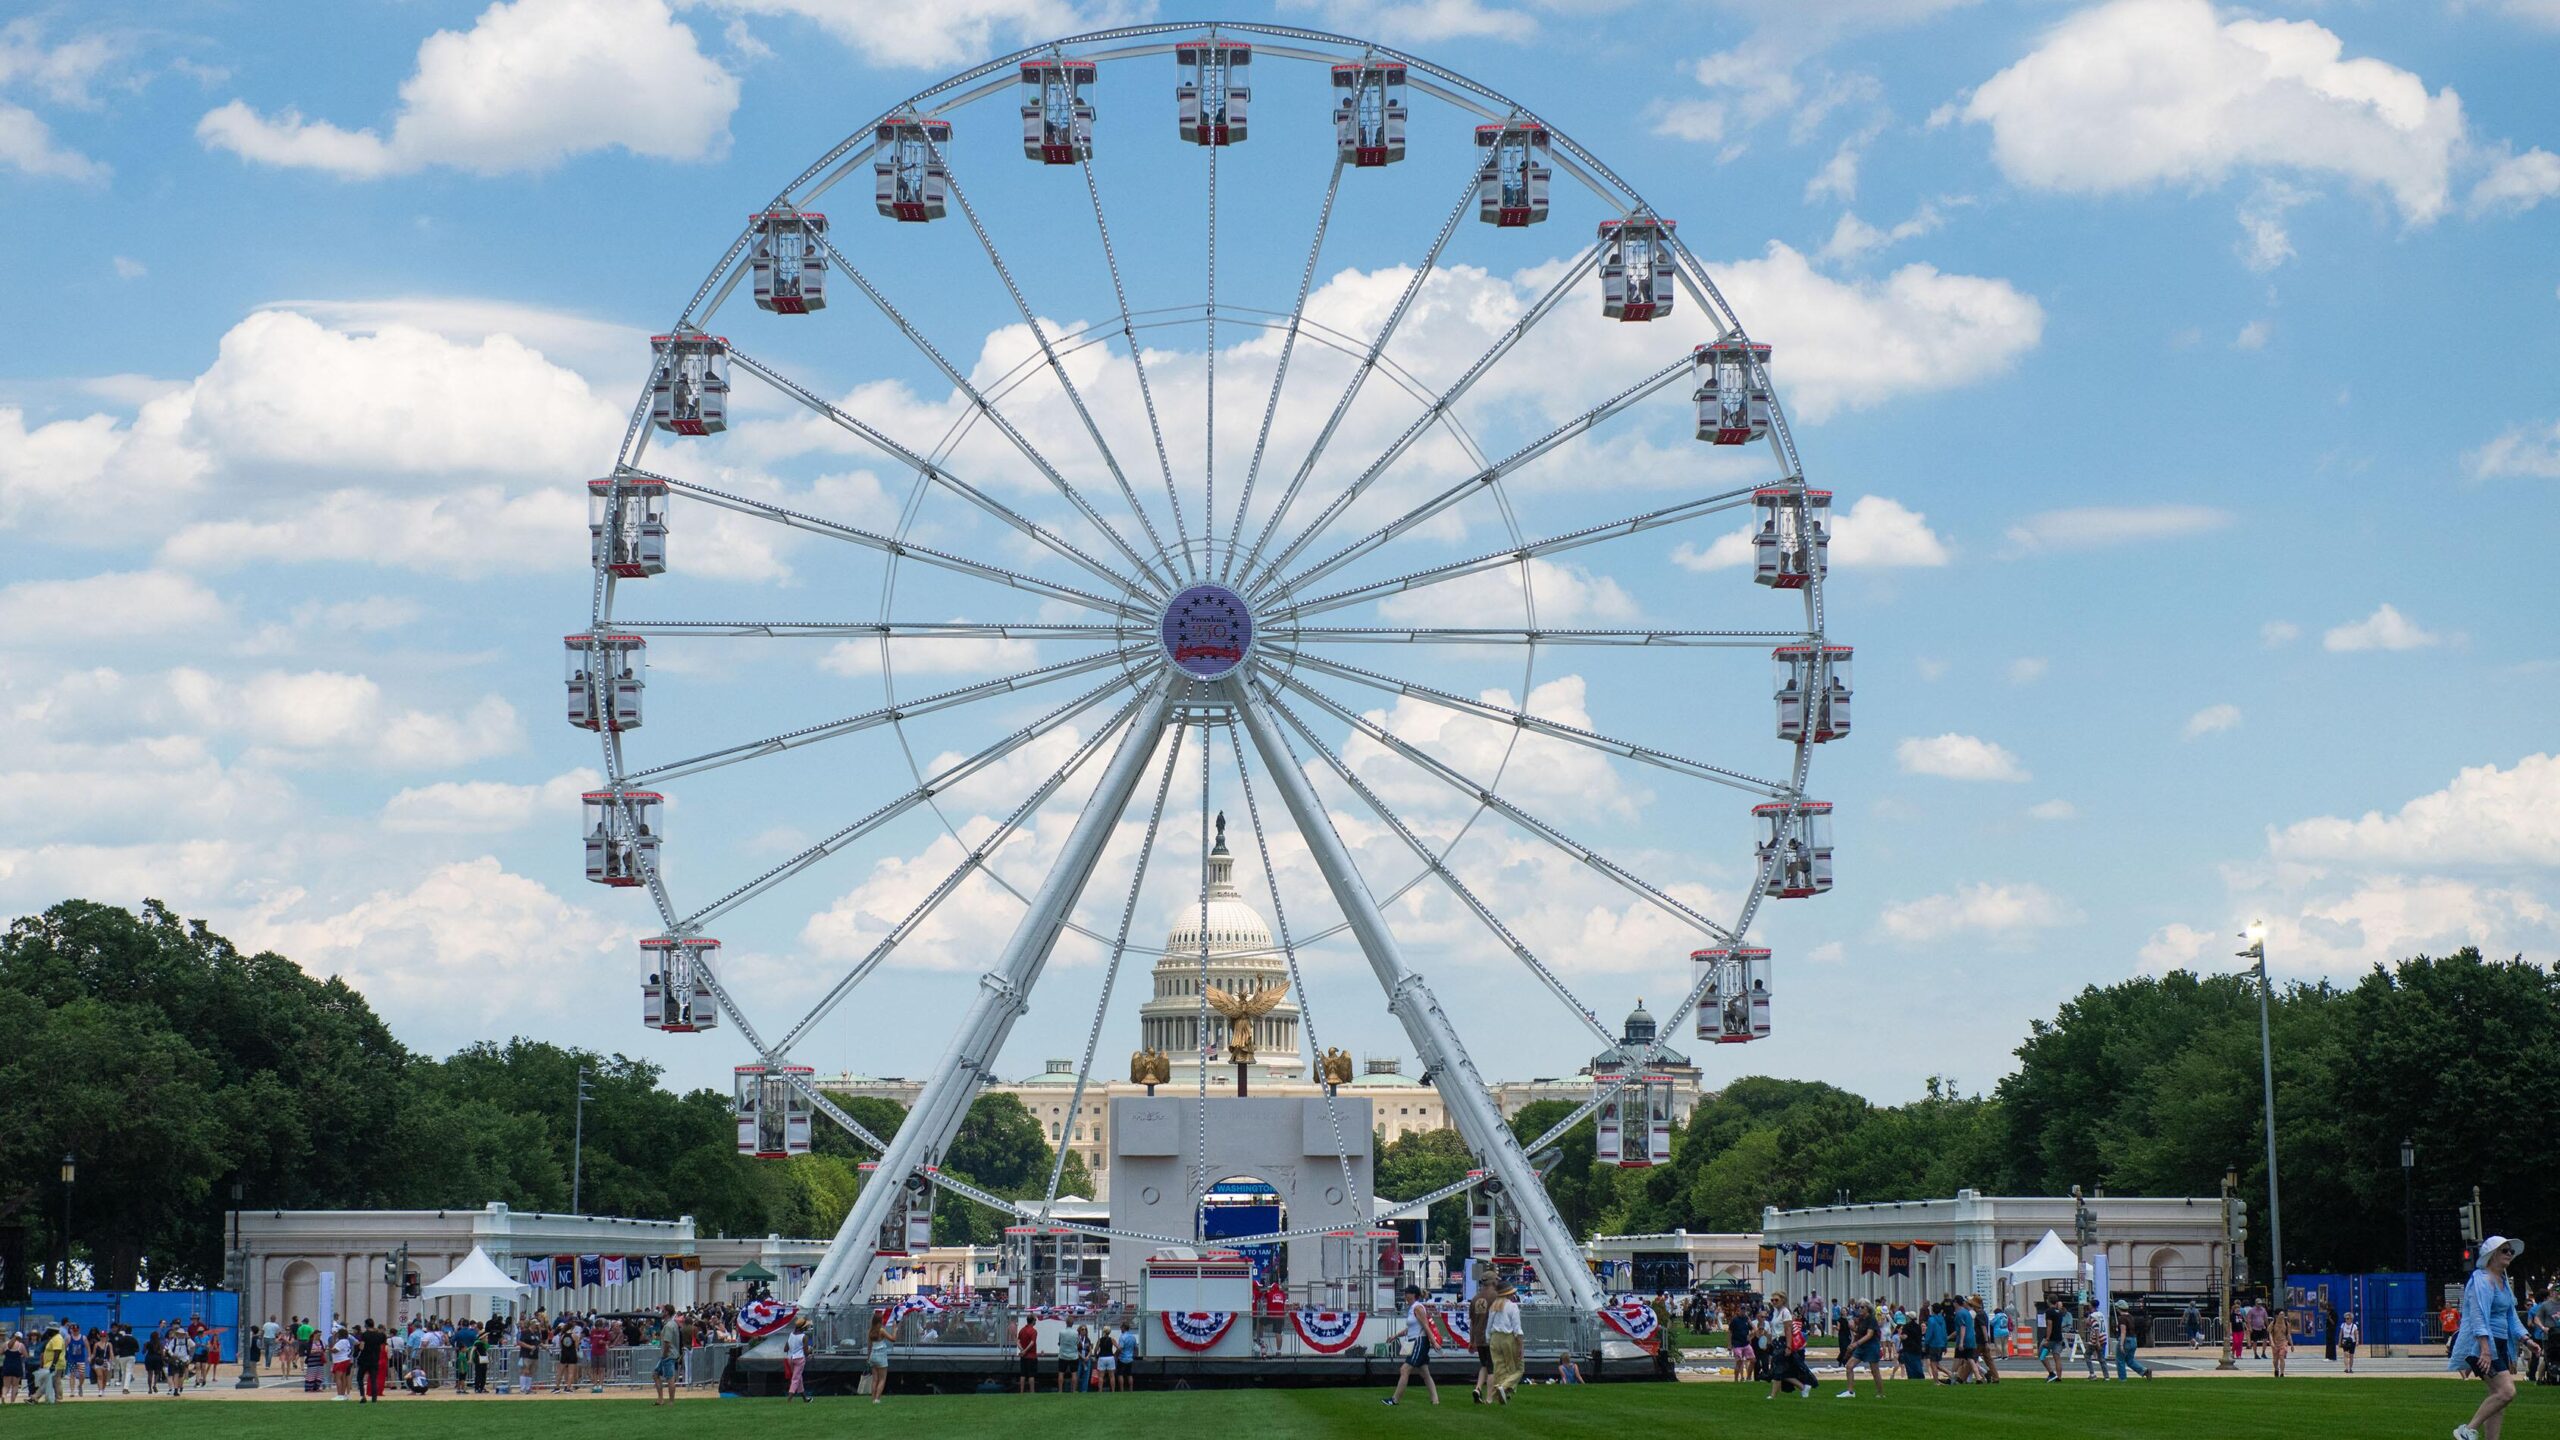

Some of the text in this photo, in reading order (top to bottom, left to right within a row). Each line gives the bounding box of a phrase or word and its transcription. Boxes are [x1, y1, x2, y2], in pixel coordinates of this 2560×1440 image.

[1798, 1255, 1813, 1264] FOOD
[1863, 1256, 1879, 1264] FOOD
[1890, 1257, 1907, 1266] FOOD
[530, 1270, 548, 1283] WV
[558, 1270, 572, 1284] NC
[583, 1268, 600, 1277] 250
[607, 1269, 620, 1281] DC
